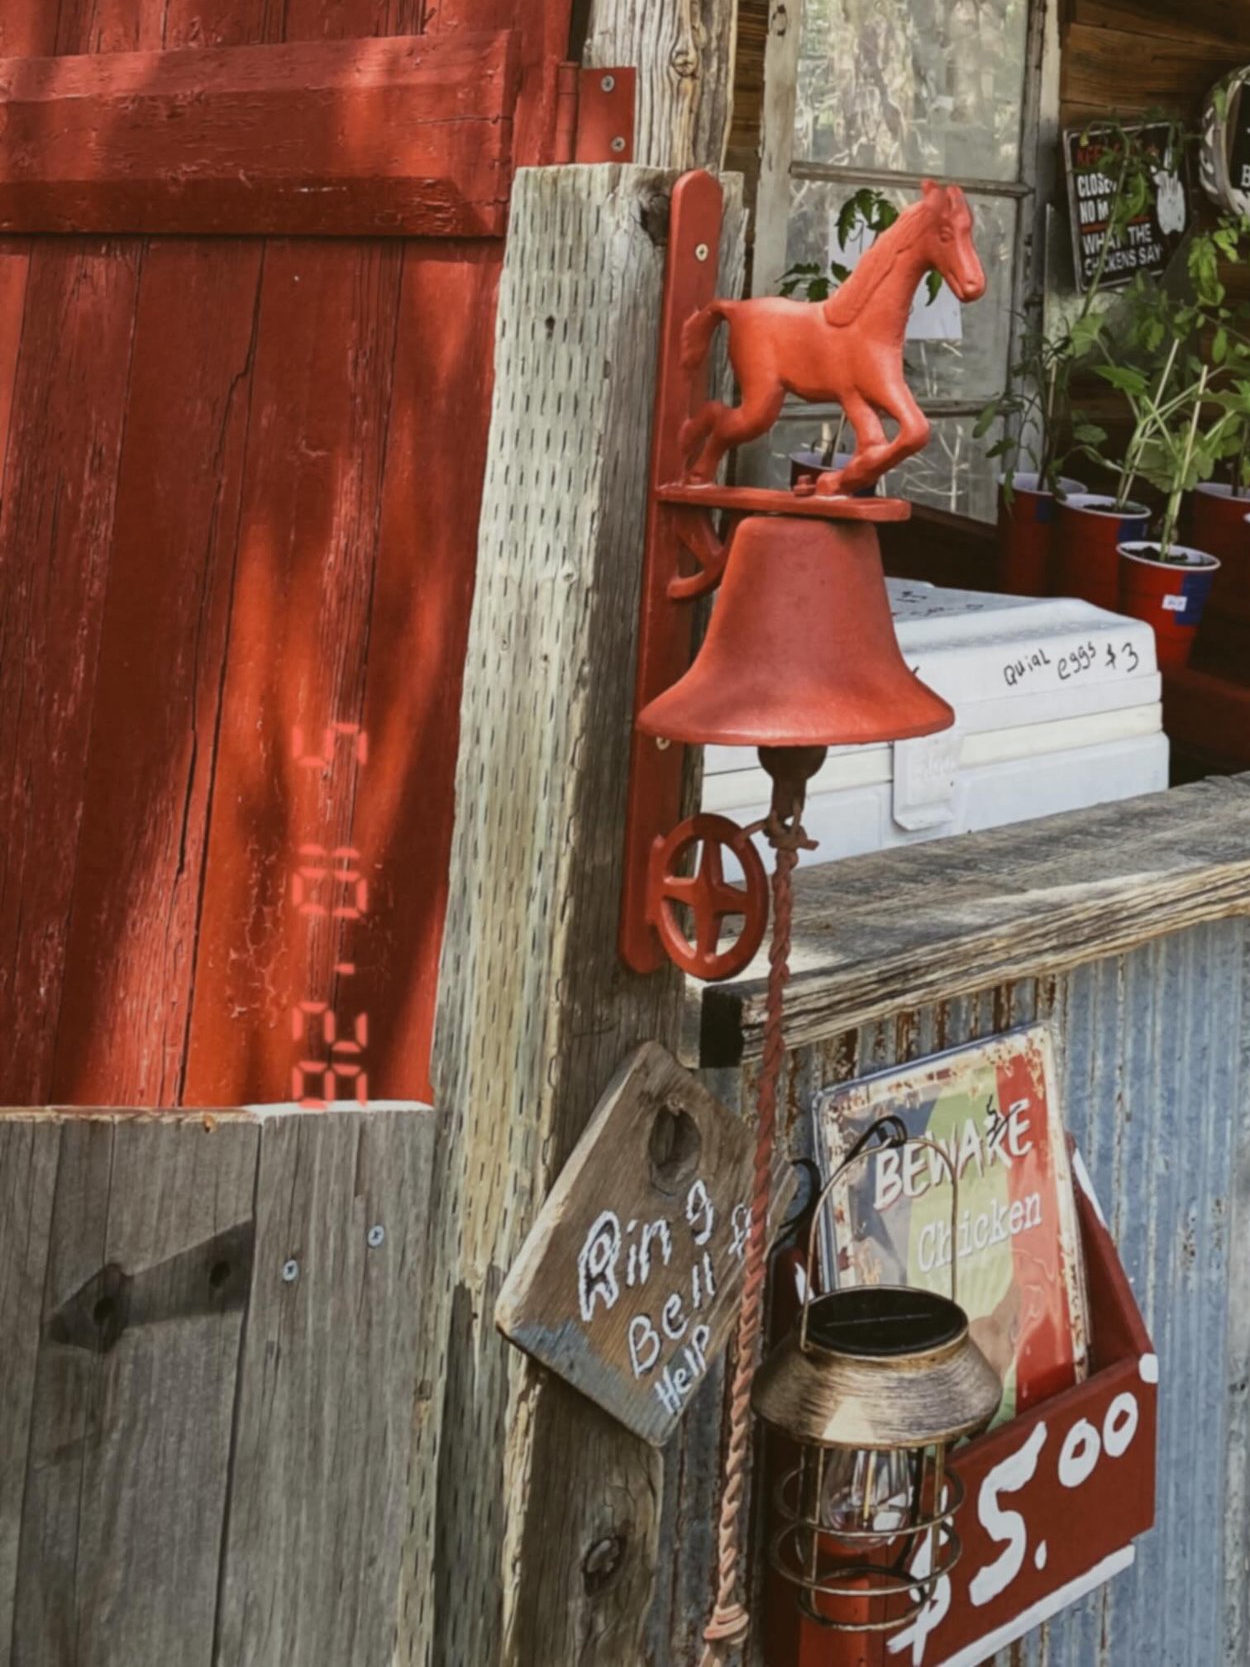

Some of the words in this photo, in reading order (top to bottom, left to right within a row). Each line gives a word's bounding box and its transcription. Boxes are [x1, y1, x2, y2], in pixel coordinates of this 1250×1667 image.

[1080, 200, 1096, 224] NO
[1127, 223, 1152, 245] THE
[1085, 249, 1137, 277] CHCKENS
[1057, 641, 1097, 680] eggs
[873, 1098, 1033, 1211] BEWARE
[577, 1179, 714, 1322] Ring
[917, 1191, 1042, 1273] Chicken
[628, 1251, 716, 1379] Bell
[654, 1324, 710, 1415] Help
